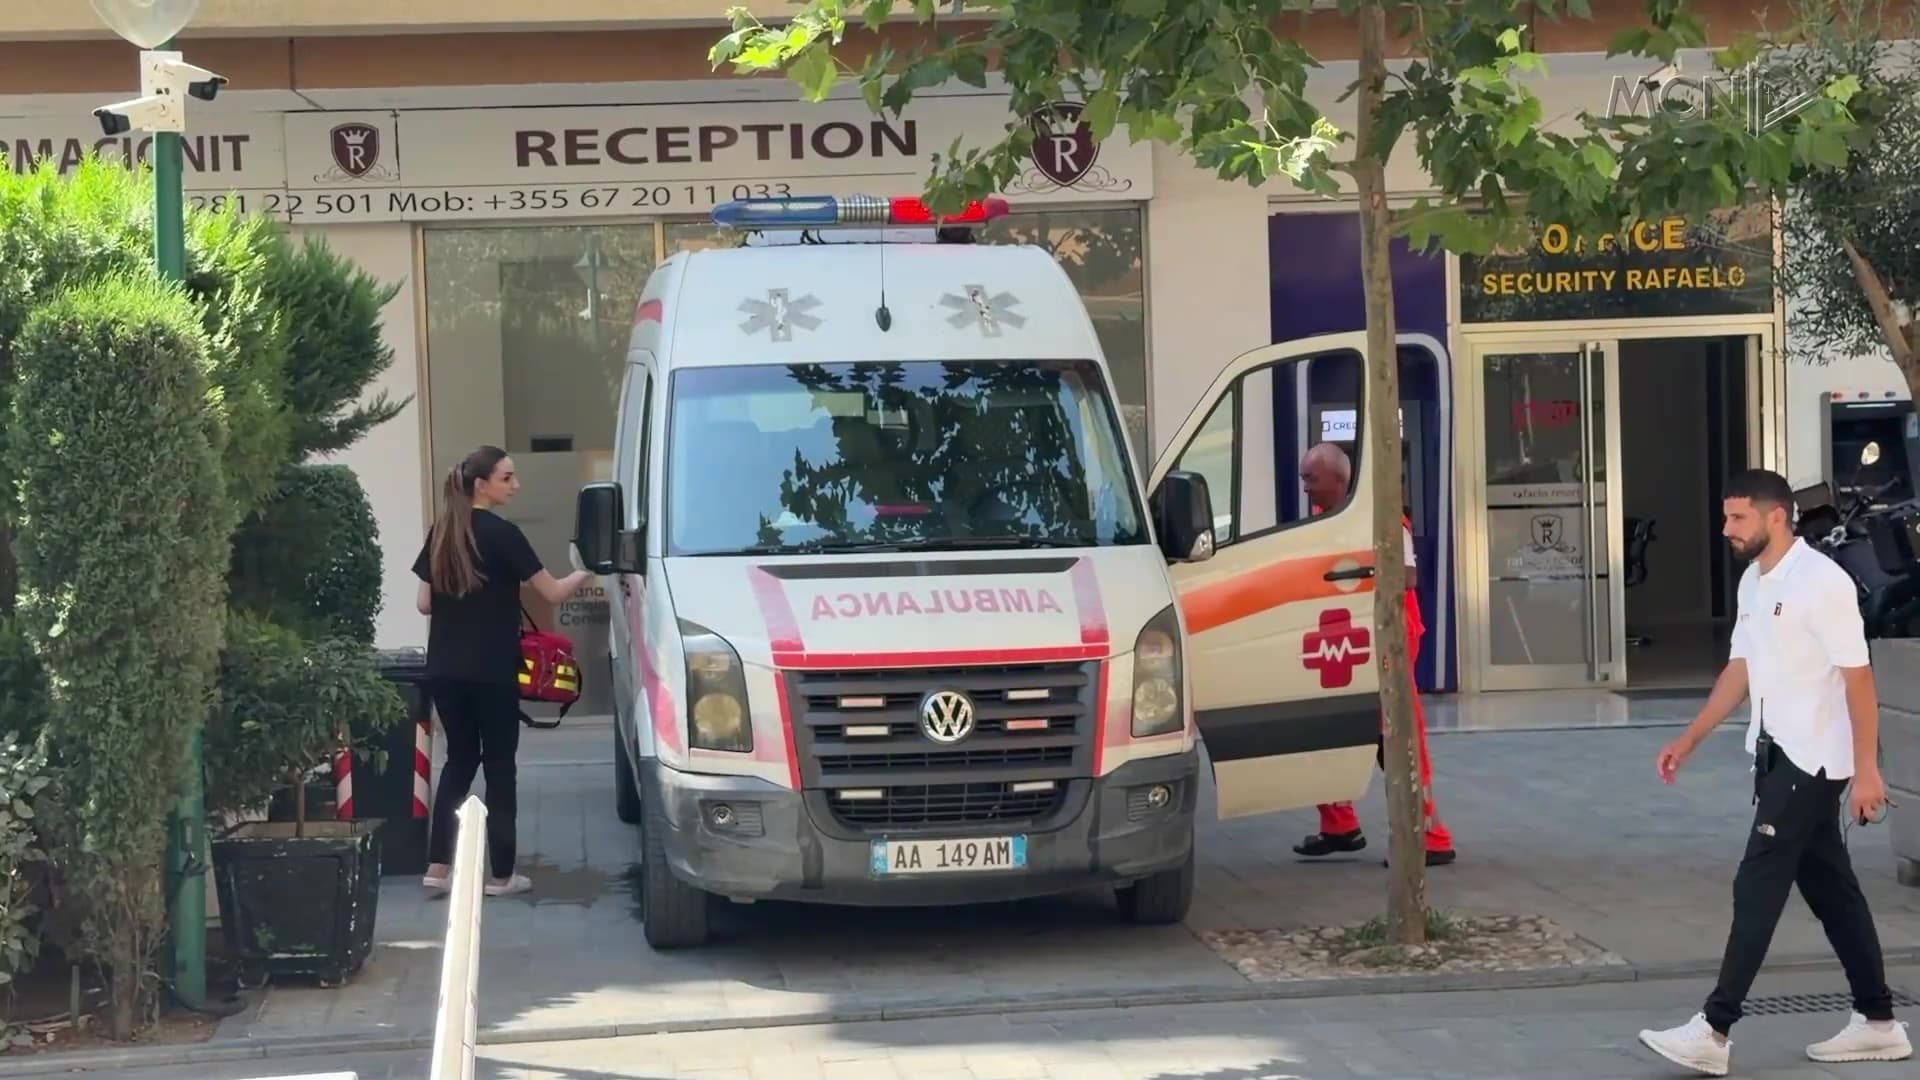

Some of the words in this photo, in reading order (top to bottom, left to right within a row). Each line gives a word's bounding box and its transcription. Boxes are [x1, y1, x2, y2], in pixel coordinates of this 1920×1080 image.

[515, 120, 917, 168] RECEPTION
[1050, 136, 1080, 173] R
[263, 194, 303, 214] 22
[316, 193, 371, 214] 501
[389, 191, 473, 213] Mob:
[484, 189, 568, 210] +355
[580, 188, 619, 208] 67
[632, 186, 671, 206] 20
[684, 185, 716, 205] 11
[732, 183, 792, 201] 033
[1542, 216, 1685, 254] OCE
[1483, 270, 1617, 296] SECURITY
[1625, 265, 1745, 291] RAFAELO
[894, 844, 922, 869] AA
[936, 843, 978, 868] 149
[983, 841, 1010, 866] AM
